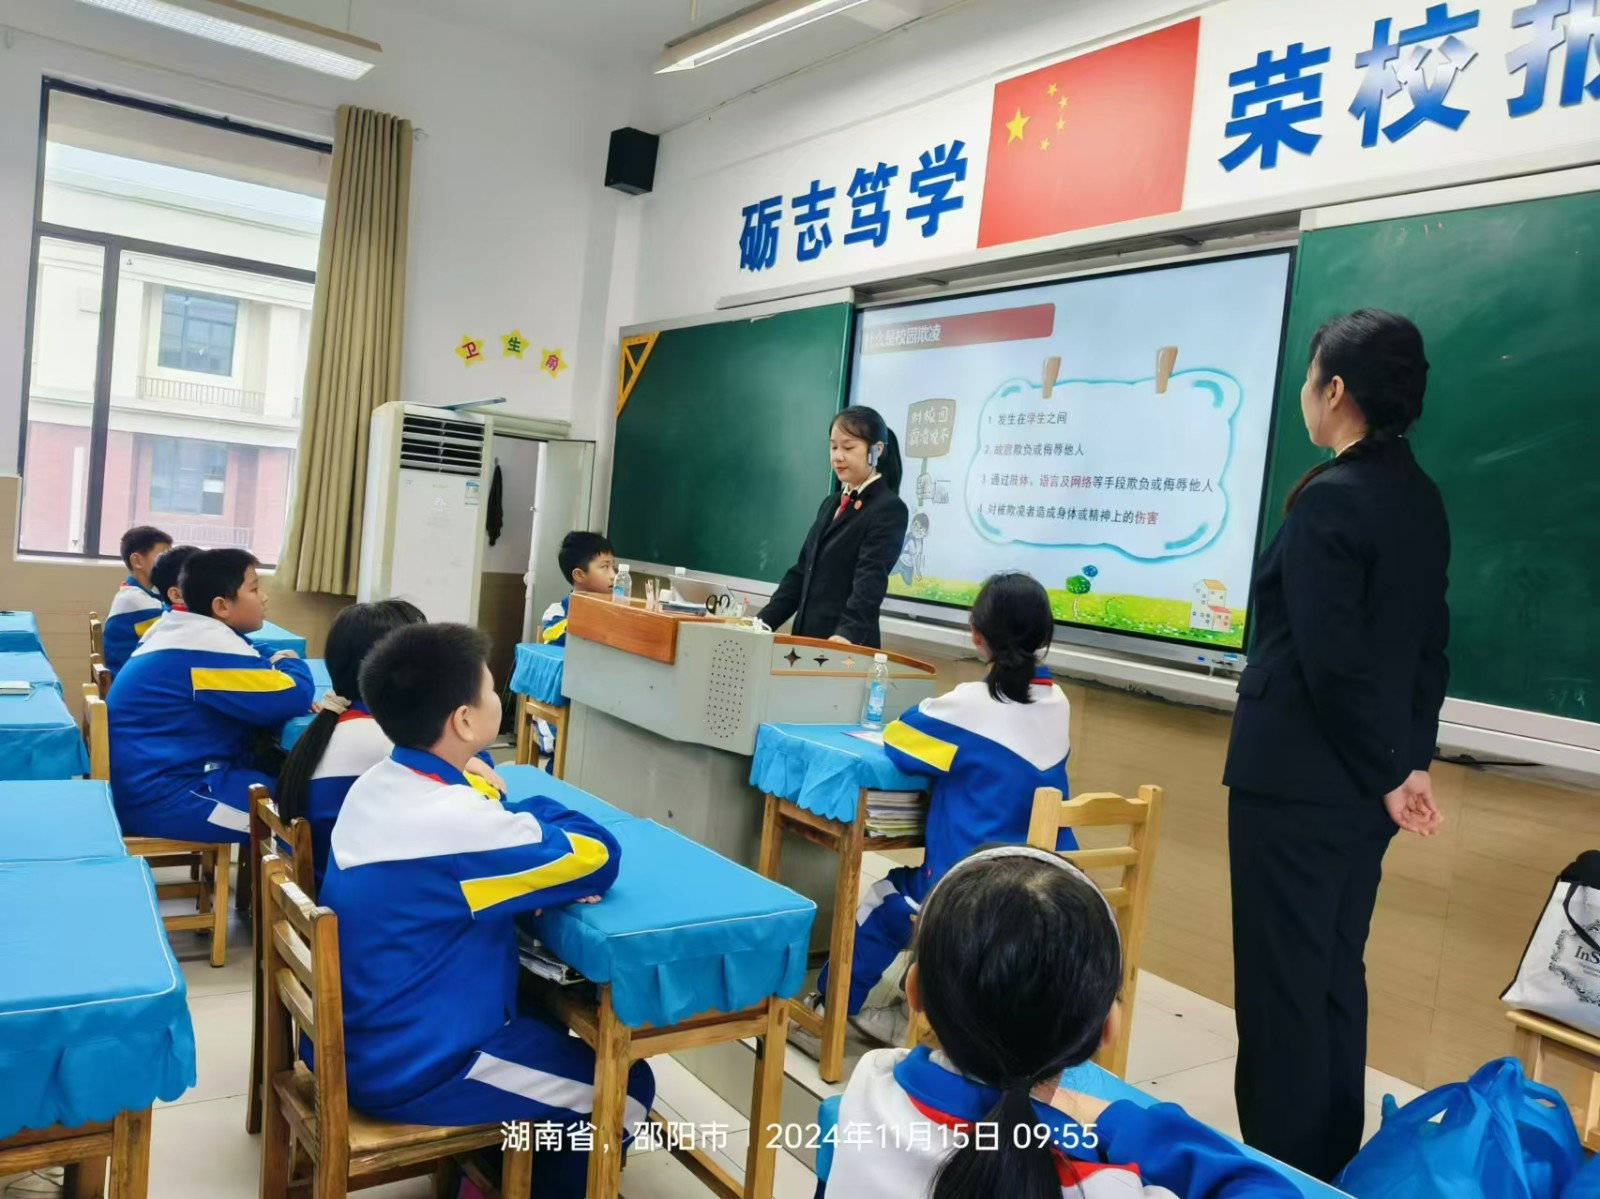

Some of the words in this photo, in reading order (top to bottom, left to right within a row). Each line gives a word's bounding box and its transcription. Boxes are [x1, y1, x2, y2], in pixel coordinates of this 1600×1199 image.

[739, 139, 968, 273] 砺志笃学
[998, 411, 1067, 425] 发生在学生之间
[994, 443, 1084, 456] 故意欺负或侮辱他人
[991, 473, 1214, 493] 通过肢体、语言及网络等手段欺负或侮辱他人
[988, 504, 1158, 525] 对被欺凌者造成身体或精神上的伤害
